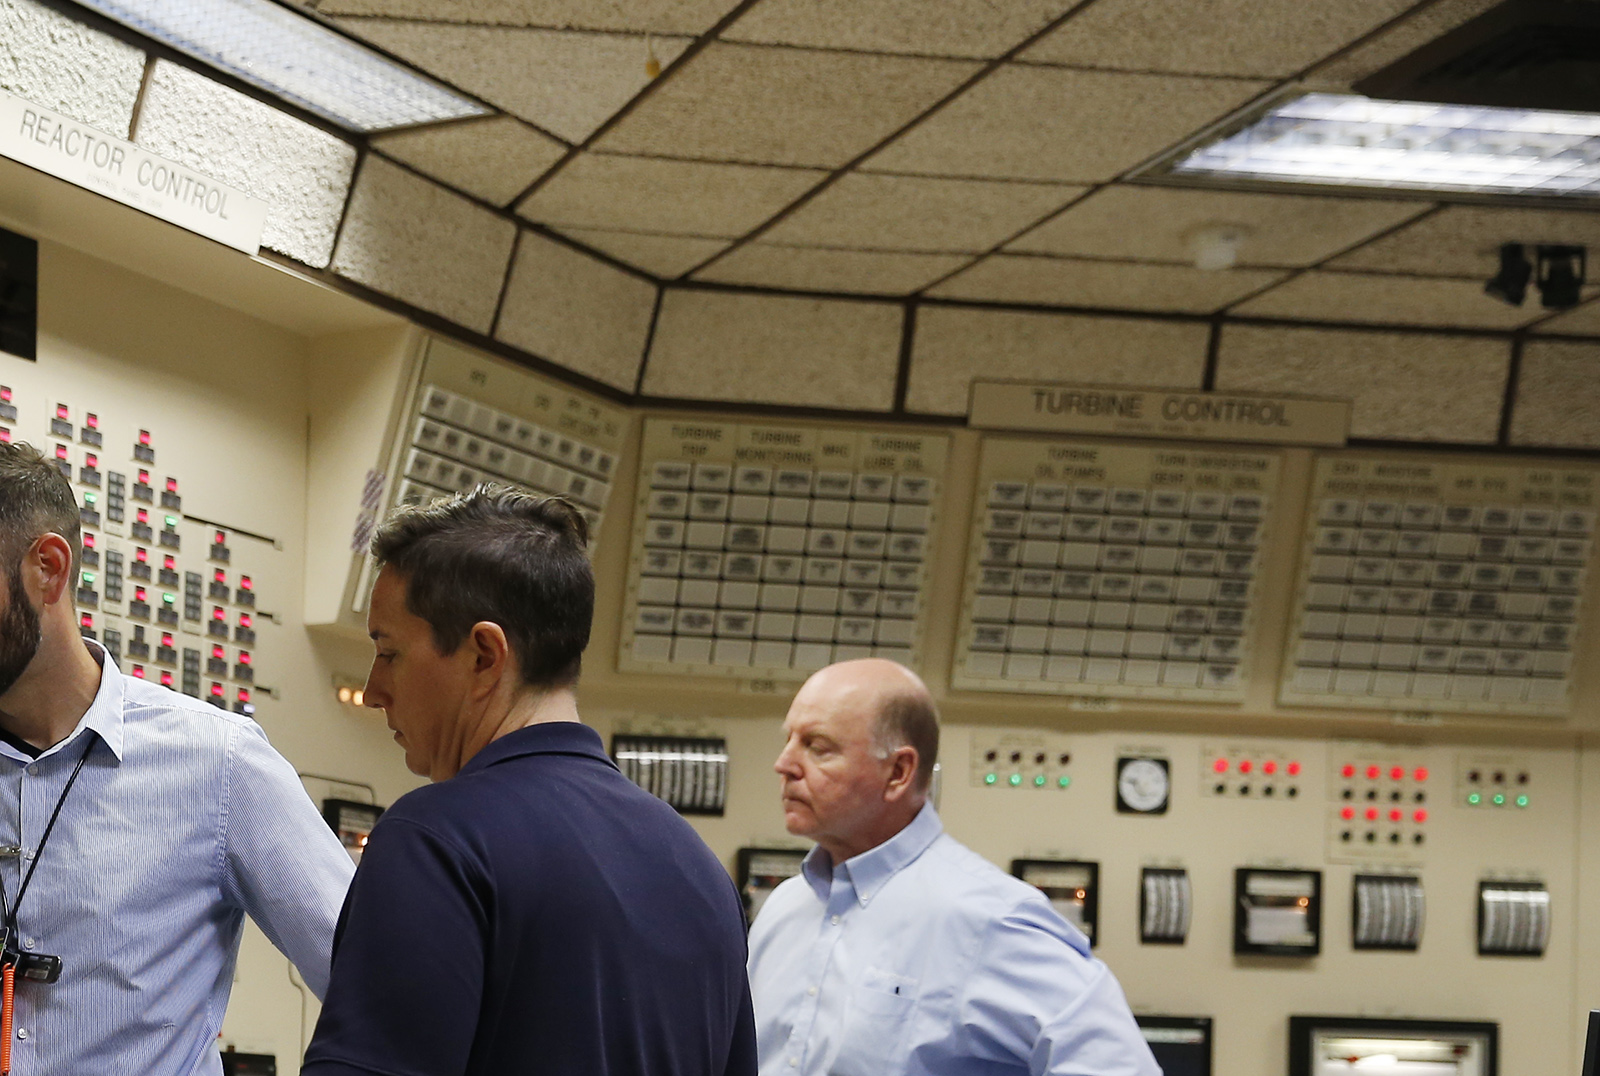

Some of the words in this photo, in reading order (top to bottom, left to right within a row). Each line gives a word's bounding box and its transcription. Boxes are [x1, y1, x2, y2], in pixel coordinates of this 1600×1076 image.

[20, 109, 126, 175] REACTOR
[137, 160, 230, 221] CONTROL
[1031, 389, 1144, 420] TURBINE
[1161, 396, 1292, 427] CONTROL
